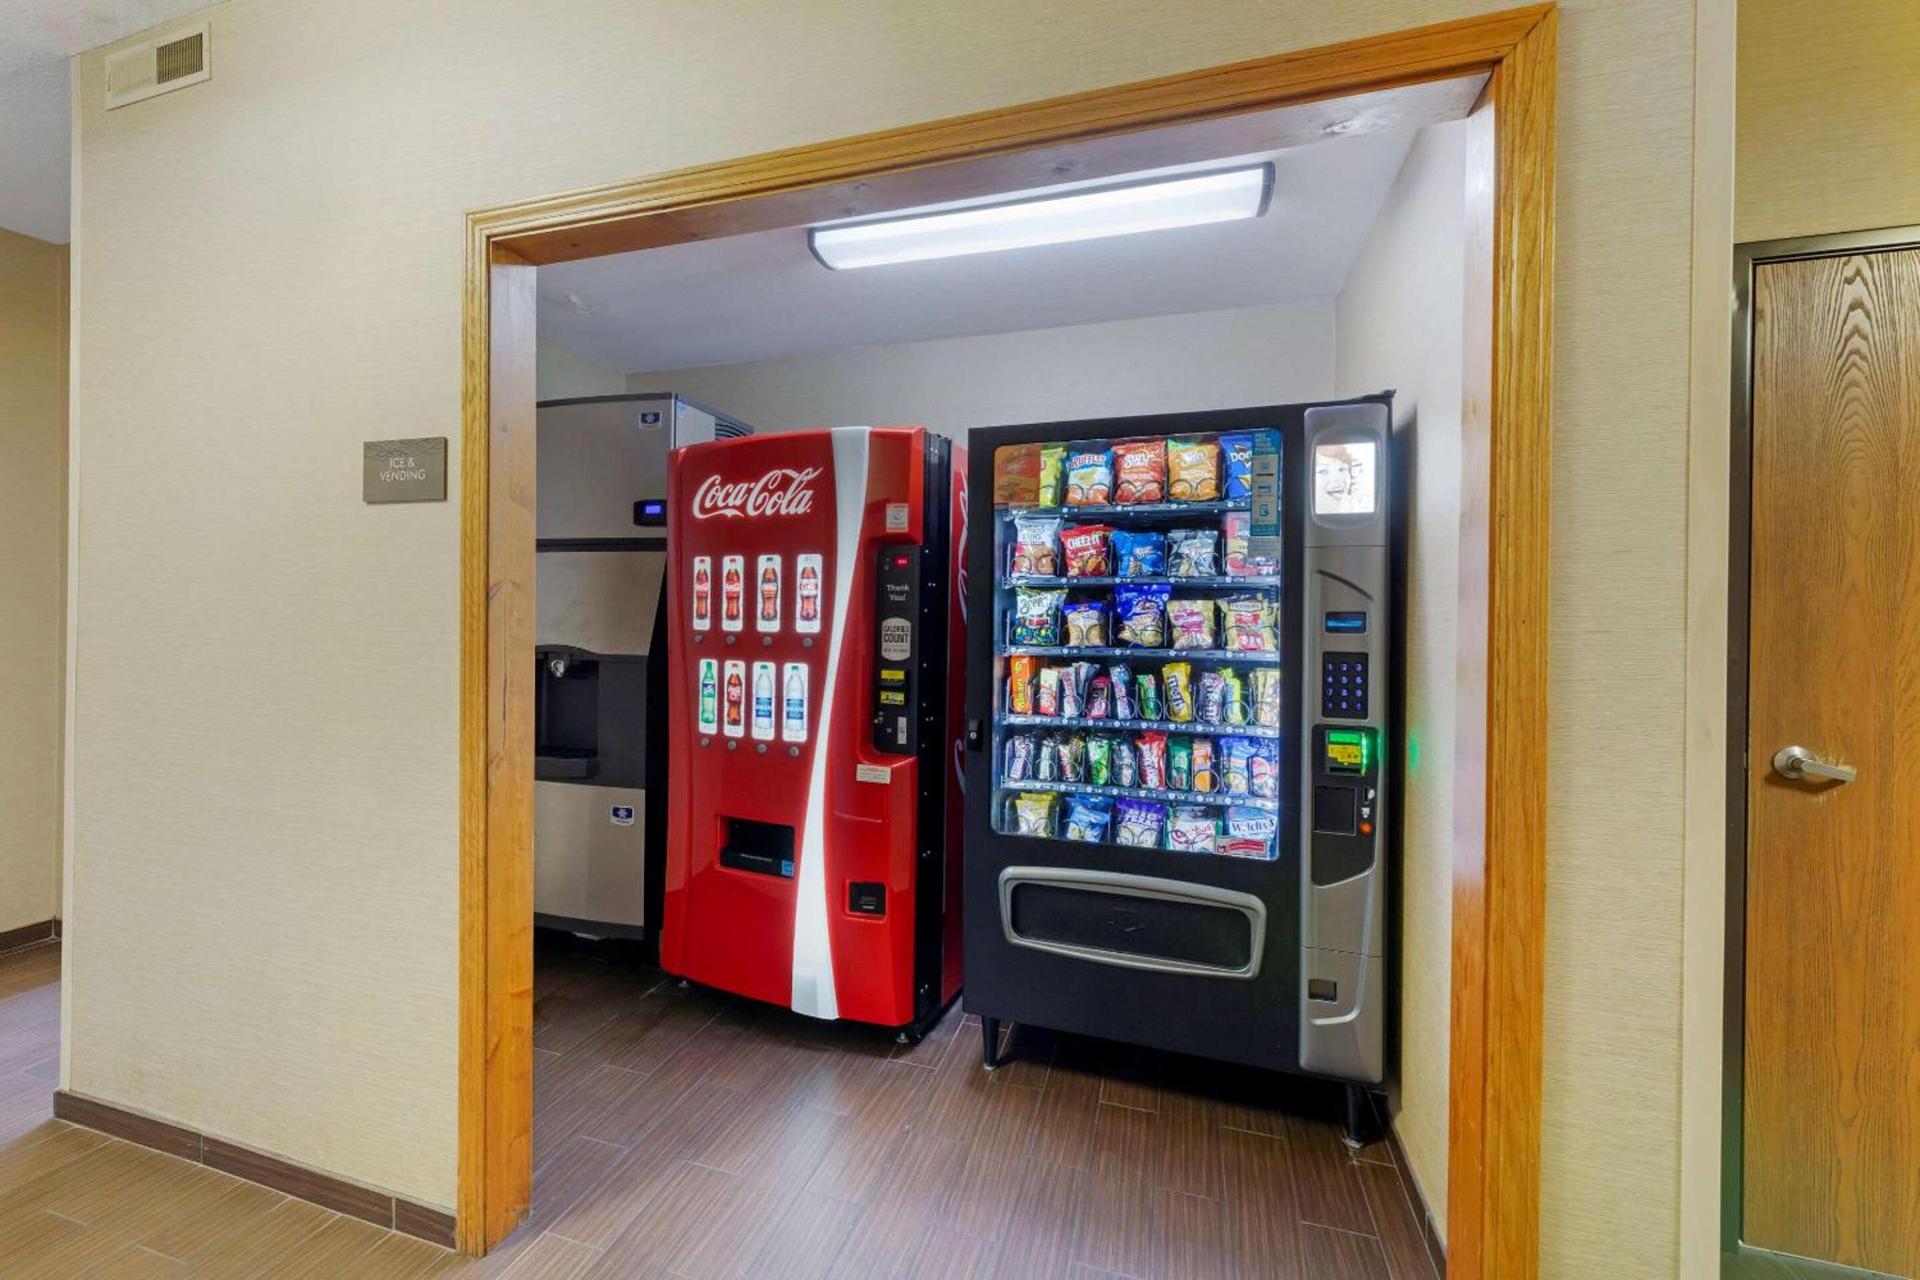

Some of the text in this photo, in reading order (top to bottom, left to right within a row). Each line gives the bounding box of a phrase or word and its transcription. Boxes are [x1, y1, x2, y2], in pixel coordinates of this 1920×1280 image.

[389, 457, 416, 469] ICE &
[379, 468, 426, 482] VENDING
[693, 467, 823, 519] Coca-Cola
[886, 584, 910, 592] Thank
[883, 625, 910, 633] CALORIES
[883, 633, 909, 643] COUNT
